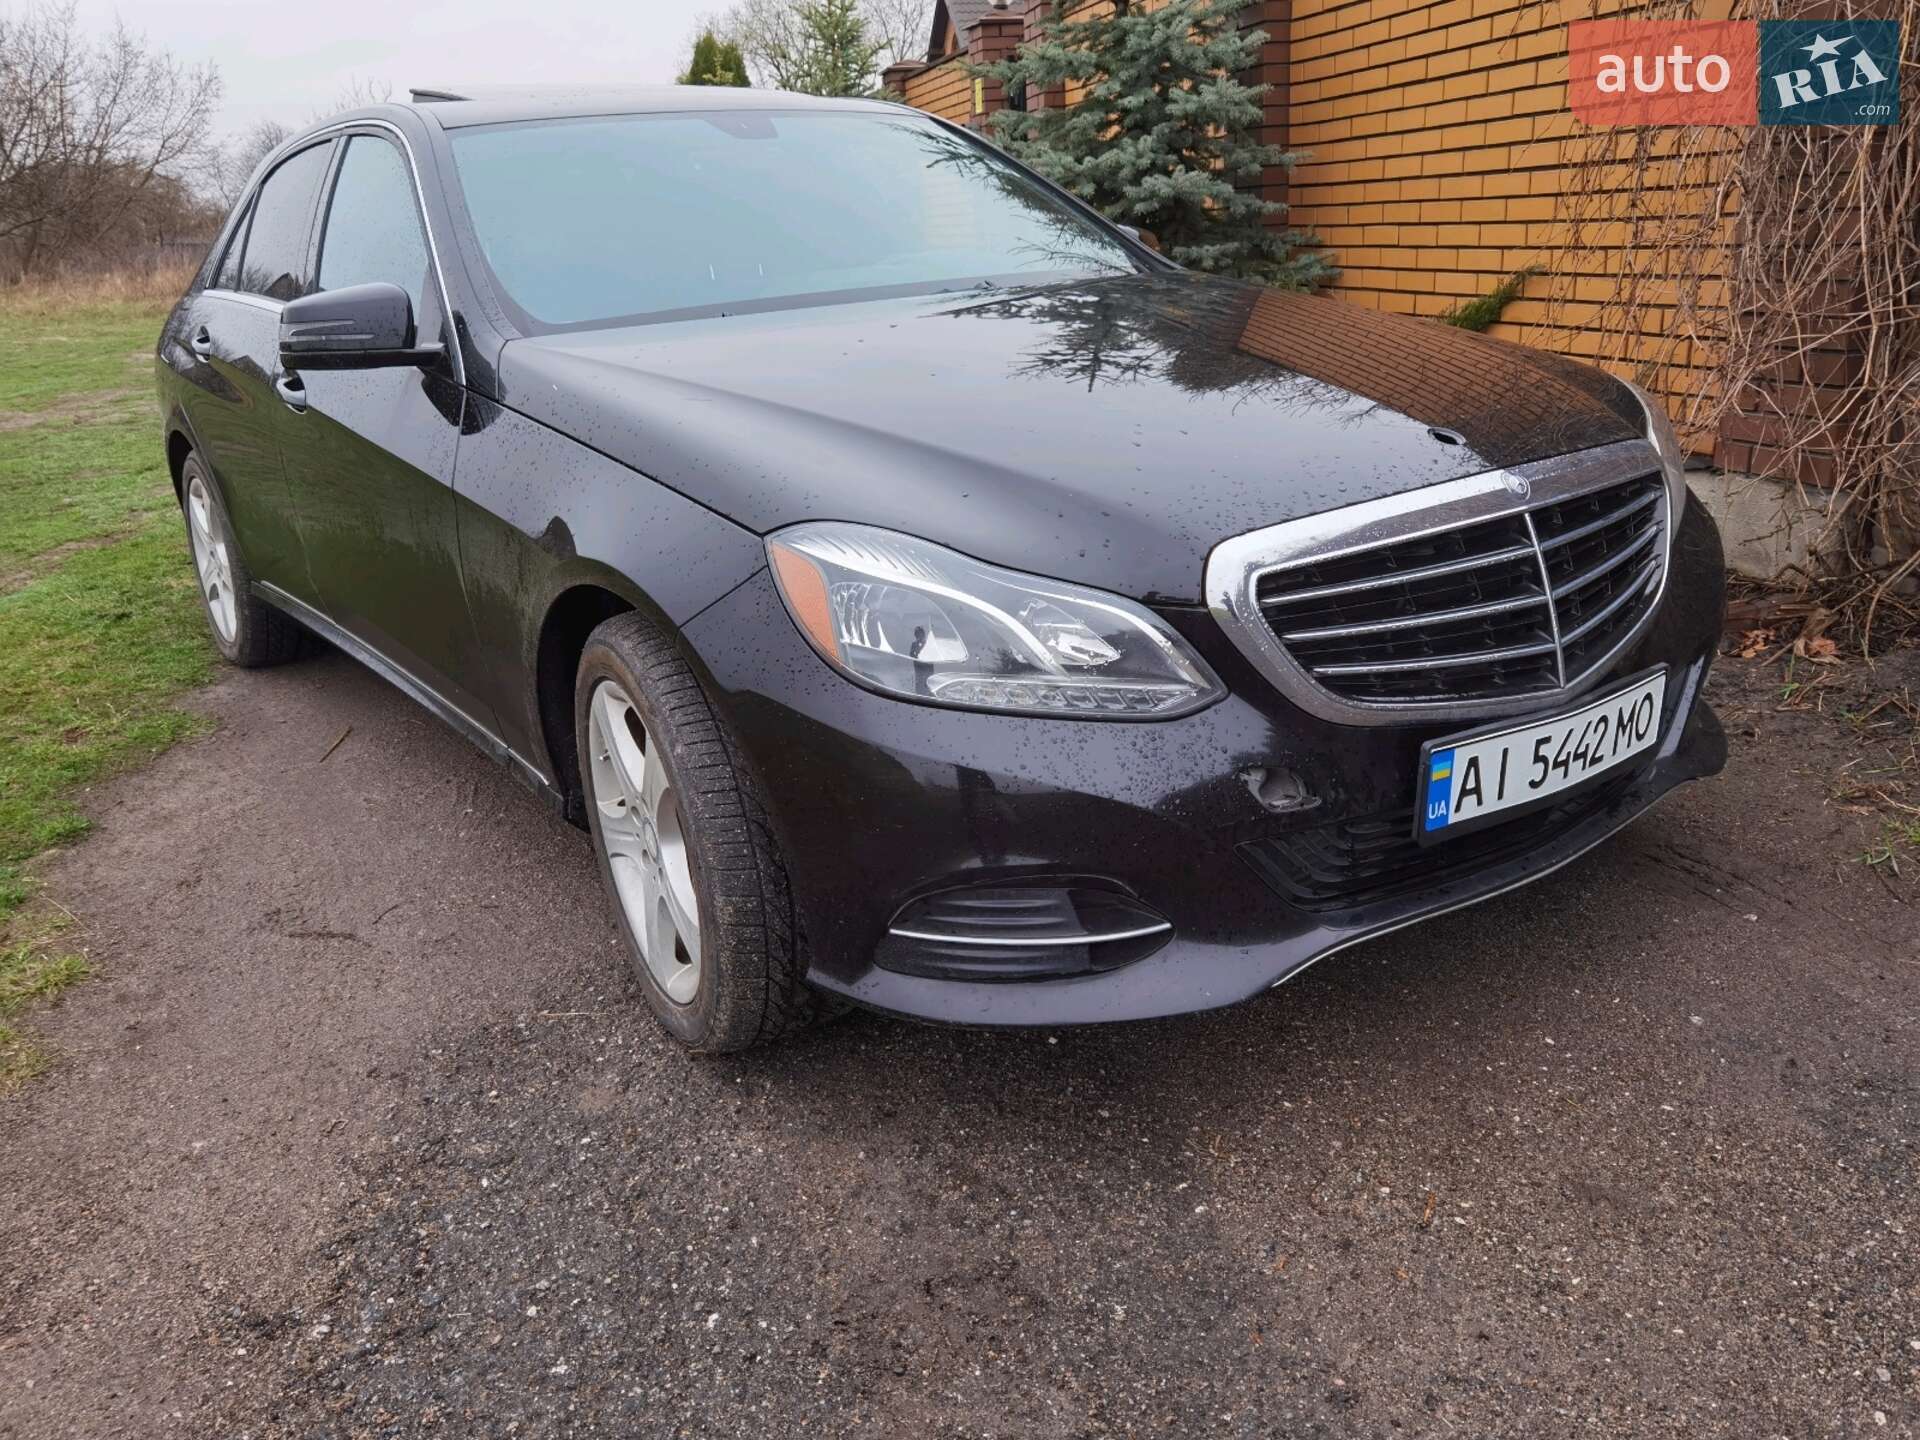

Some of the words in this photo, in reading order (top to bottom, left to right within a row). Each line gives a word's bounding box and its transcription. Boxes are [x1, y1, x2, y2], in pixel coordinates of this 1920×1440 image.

[1454, 747, 1509, 813] AI
[1528, 715, 1609, 789] 5442
[1612, 692, 1654, 756] MO
[1428, 799, 1448, 819] UA
